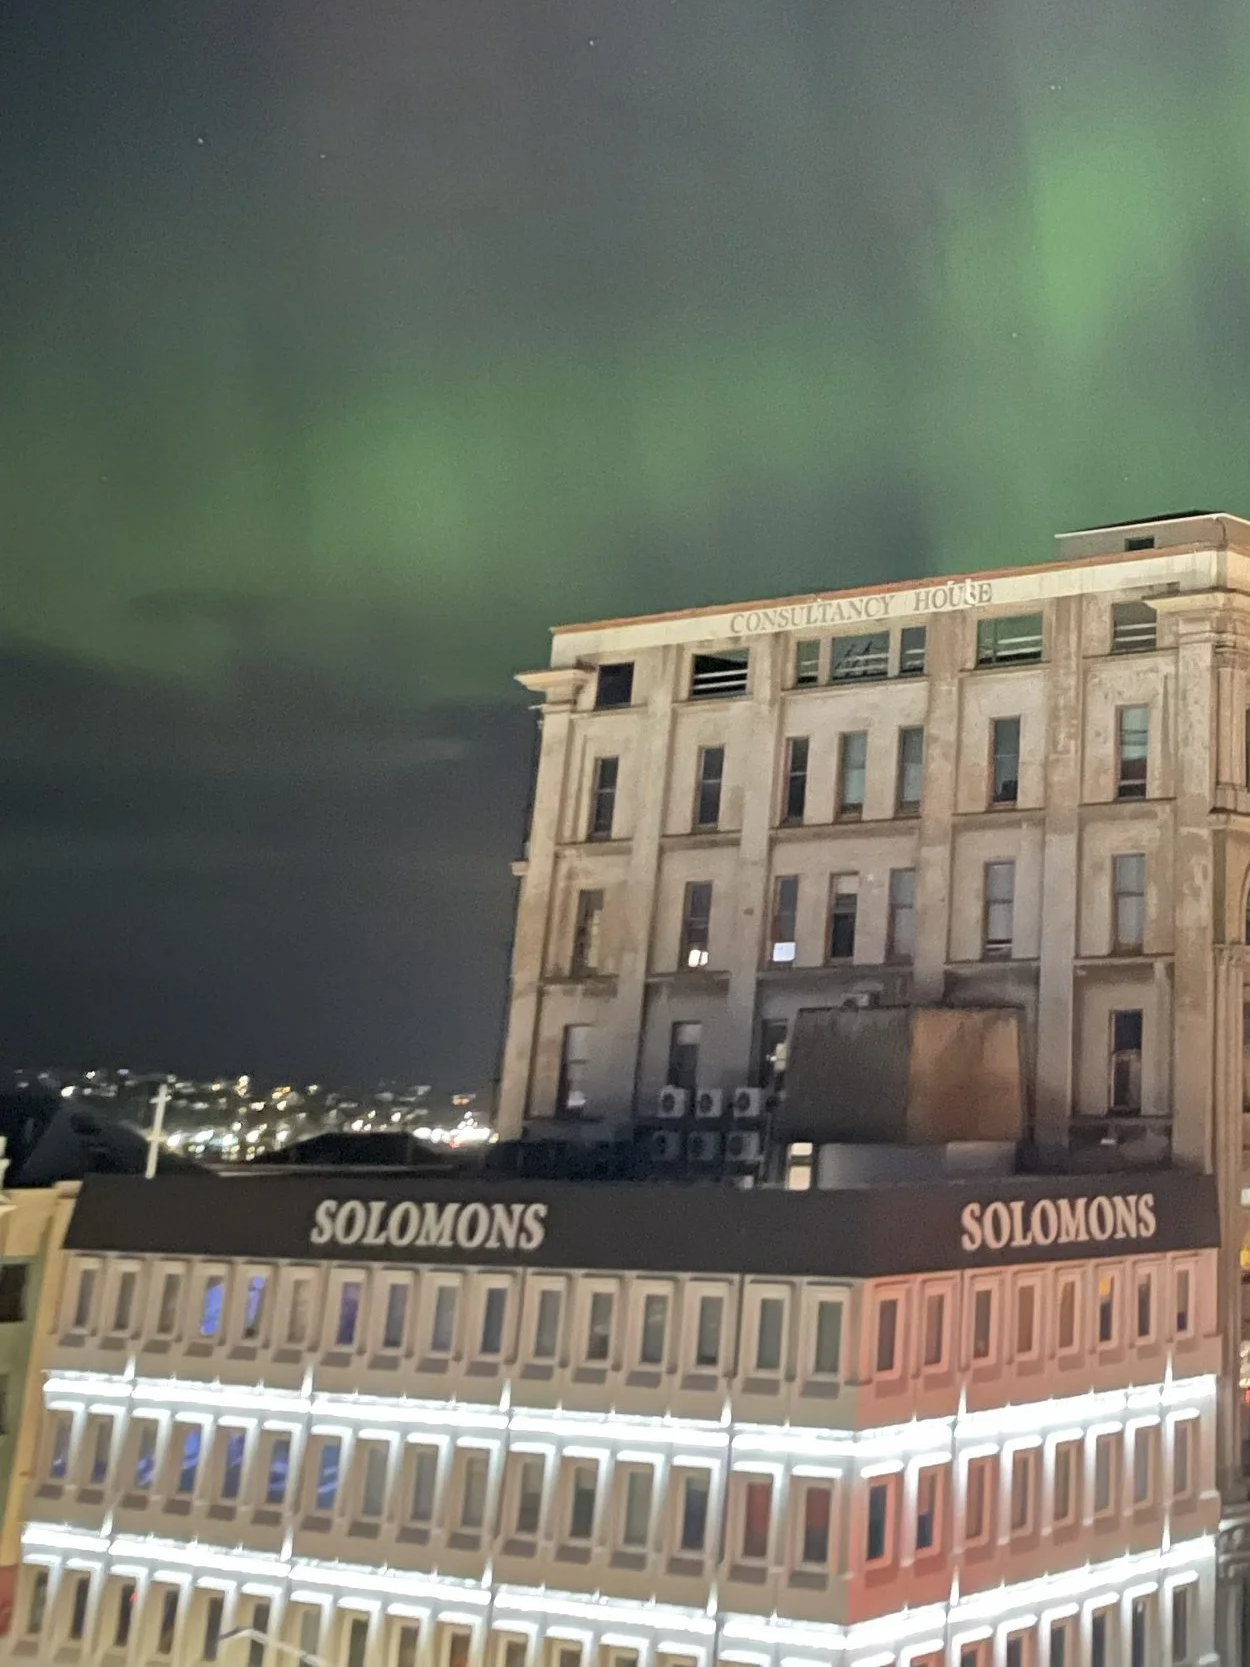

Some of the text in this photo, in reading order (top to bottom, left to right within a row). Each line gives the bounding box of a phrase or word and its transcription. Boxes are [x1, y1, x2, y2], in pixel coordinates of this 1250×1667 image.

[729, 594, 895, 634] CONSULTANCY
[310, 1199, 548, 1250] SOLOMONS
[960, 1193, 1157, 1252] SOLOMONS
